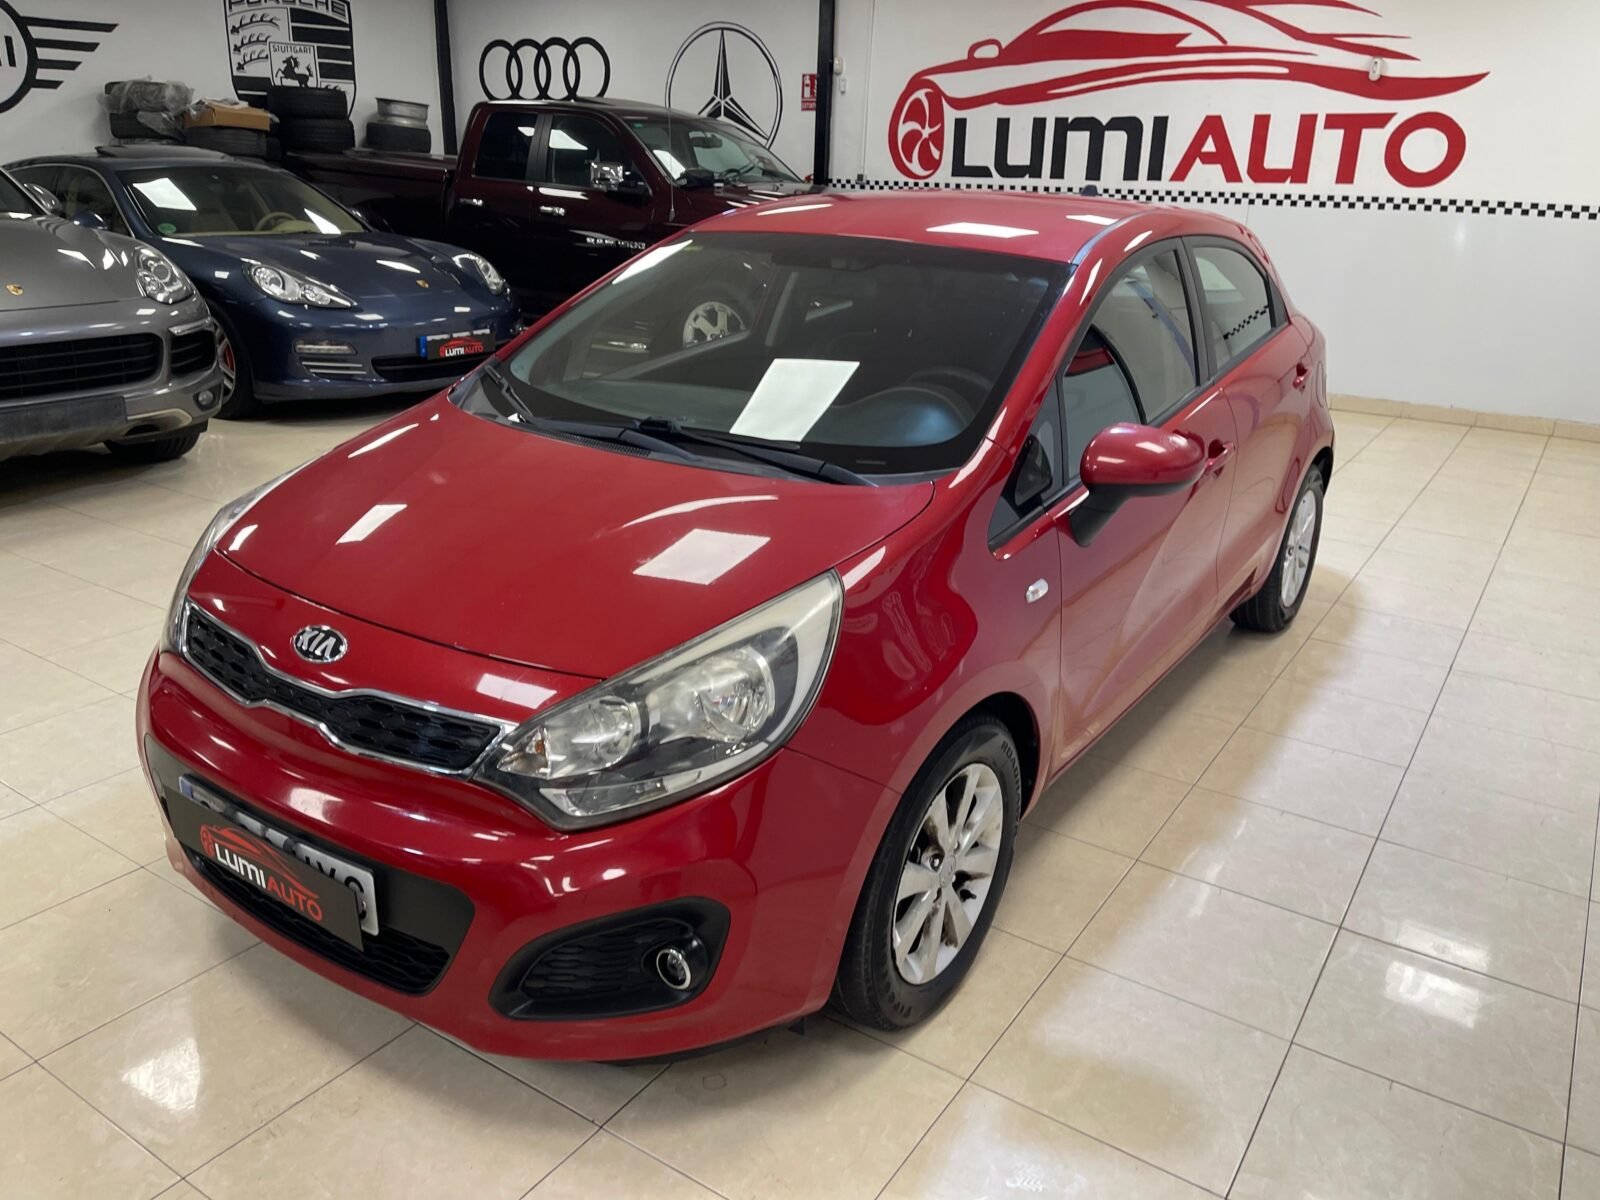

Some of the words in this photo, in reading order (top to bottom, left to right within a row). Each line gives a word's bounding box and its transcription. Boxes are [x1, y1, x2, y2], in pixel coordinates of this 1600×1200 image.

[272, 44, 312, 54] STUTTGART
[950, 111, 1467, 188] LUMIAUTO
[445, 345, 484, 357] LUMIAUTO
[297, 630, 337, 659] KIA
[214, 842, 323, 921] LUMIAUTO
